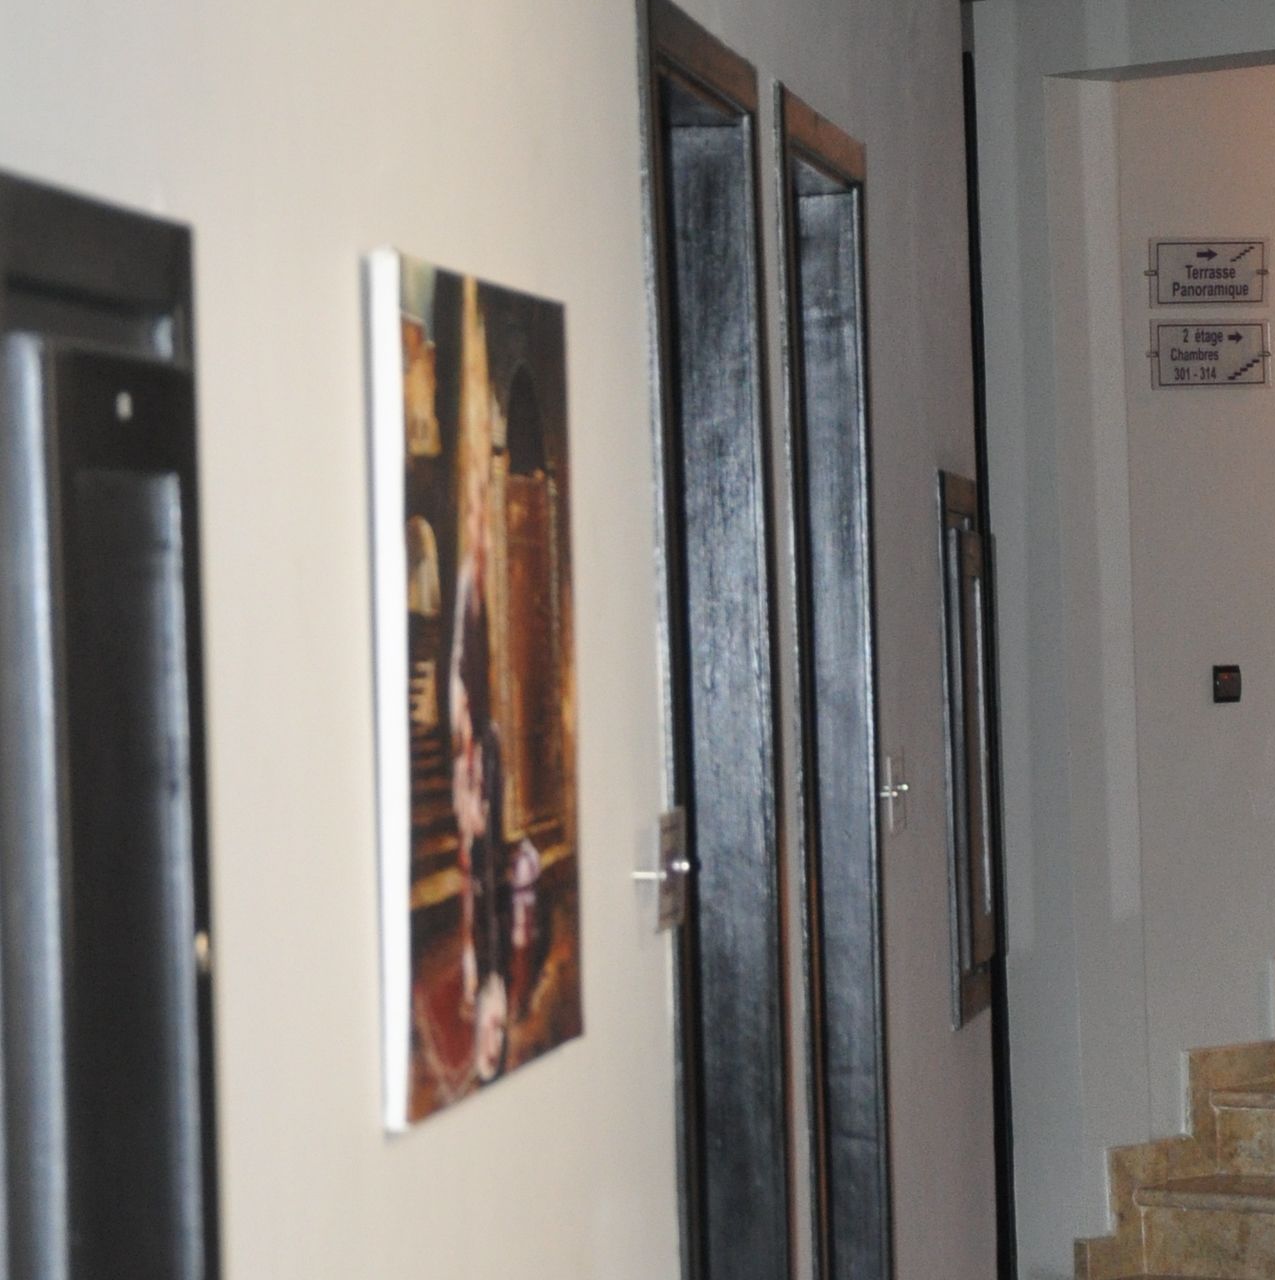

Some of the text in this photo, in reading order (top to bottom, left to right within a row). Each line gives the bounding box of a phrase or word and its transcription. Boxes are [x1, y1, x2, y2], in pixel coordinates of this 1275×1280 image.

[1185, 265, 1236, 280] Terrasse
[1172, 282, 1249, 299] Panoramique
[1183, 328, 1223, 346] 2 étage
[1170, 347, 1219, 361] Chambres
[1174, 367, 1190, 380] 301
[1200, 366, 1217, 380] 314
